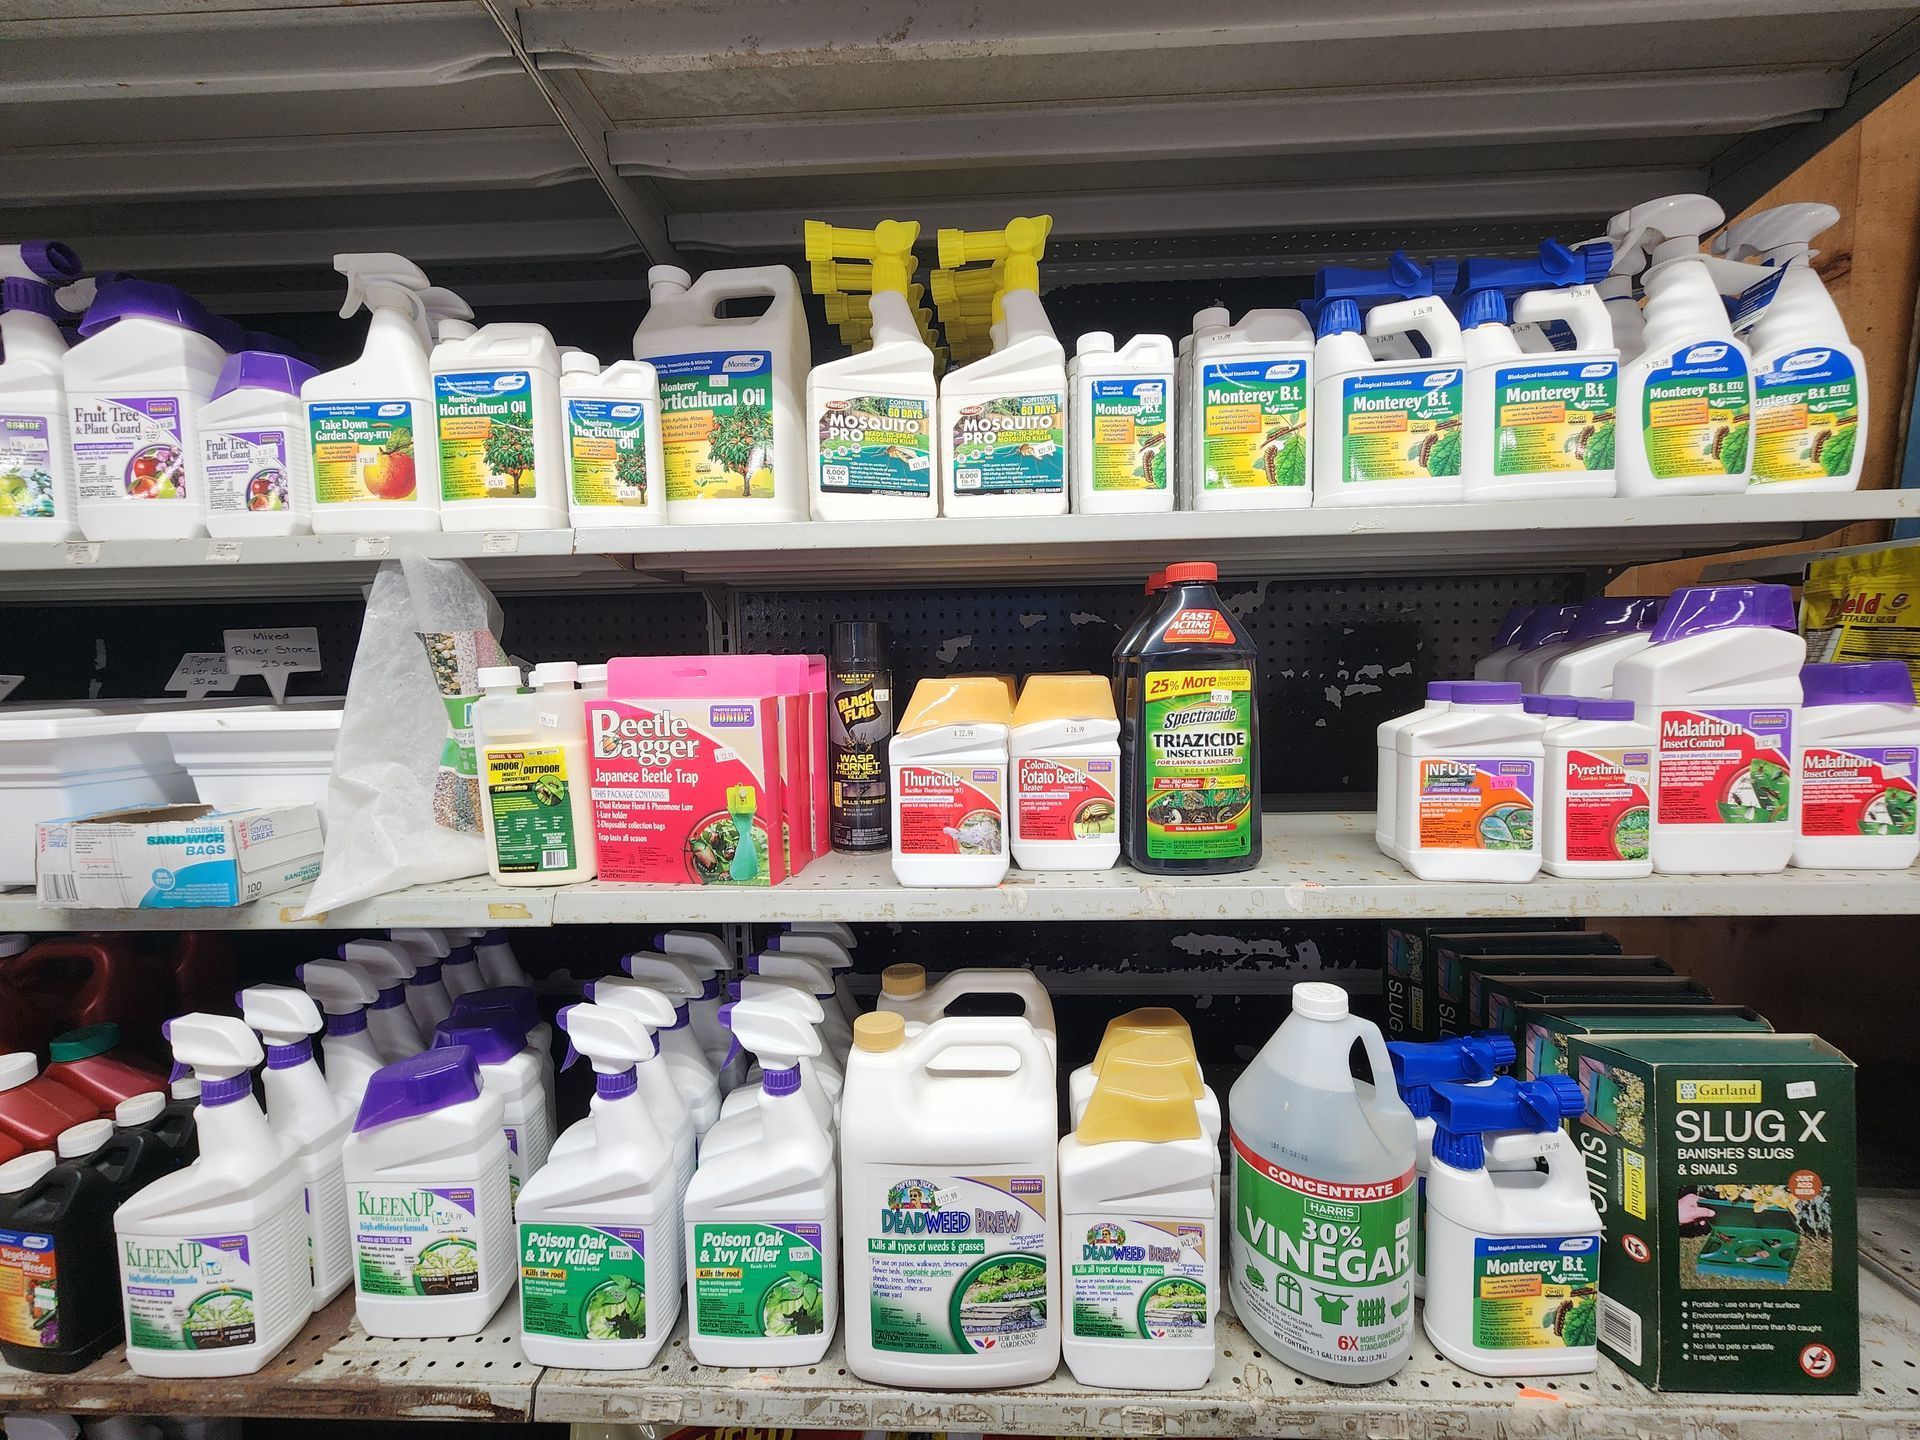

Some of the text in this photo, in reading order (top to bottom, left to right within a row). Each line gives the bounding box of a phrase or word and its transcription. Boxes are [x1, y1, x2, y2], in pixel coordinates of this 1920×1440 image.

[1537, 370, 1568, 378] Insecticide
[661, 382, 695, 392] Monterey
[1506, 383, 1607, 403] Monterey B.t.
[1650, 382, 1743, 399] Monterey B.t. RTU
[660, 388, 765, 410] orticultural Oil
[1208, 386, 1302, 404] Monterey B.t.
[440, 401, 526, 416] Horticultural Oil
[889, 400, 922, 408] CONTROLS
[1354, 392, 1451, 412] Monterey B.t.
[75, 408, 139, 422] Fruit Tree
[888, 409, 923, 419] 60 DAYS
[84, 424, 108, 434] Plant
[112, 422, 141, 434] Guard
[320, 420, 368, 430] Take Down
[583, 420, 612, 428] Monterey
[829, 414, 919, 432] MOSQUITO
[963, 416, 1052, 432] MOSQUITO
[315, 430, 392, 442] Garden Spray-RTU
[574, 425, 639, 439] Horticultural
[829, 428, 863, 442] PRO
[964, 432, 996, 444] PRO
[619, 439, 633, 449] Oil
[1181, 612, 1213, 620] FAST-
[1170, 620, 1210, 629] ACTING
[1177, 628, 1210, 636] FORMULA
[233, 646, 316, 655] River Stone
[191, 656, 213, 665] Tiger
[257, 660, 279, 668] .25
[1151, 675, 1216, 694] 25% More
[838, 688, 874, 712] BLACK
[844, 704, 876, 724] FLAG
[1164, 710, 1236, 728] Spectracide
[591, 710, 689, 737] Beetle
[1663, 720, 1742, 737] Malathion
[1154, 732, 1244, 748] TRIAZICIDE
[1662, 738, 1724, 749] Insect Control
[595, 735, 699, 766] Bagger
[1166, 748, 1234, 758] INSECT KILLER
[840, 754, 876, 763] WASP,
[1025, 760, 1059, 770] Colorado
[1805, 756, 1872, 769] Malathion
[1424, 763, 1476, 776] INFUSE
[1568, 763, 1624, 778] Pyrethrin
[1804, 769, 1858, 778] Insect Control
[595, 768, 698, 787] Japanese Beetle Trap
[903, 770, 960, 787] Thuricide
[1021, 770, 1086, 784] Potato Beetle
[186, 826, 225, 834] RECLOSABLE
[147, 834, 224, 844] SANDWICH
[599, 835, 609, 843] Trap
[185, 845, 225, 855] BAGS
[247, 882, 262, 894] 100
[1699, 1083, 1757, 1099] Garland
[1674, 1110, 1827, 1144] SLUG X
[1677, 1148, 1794, 1160] BANISHES SLUGS
[1678, 1164, 1738, 1175] & SNAILS
[1268, 1166, 1393, 1198] CONCENTRATE
[1310, 1202, 1354, 1217] HARRIS
[882, 1208, 1020, 1234] DEADWEED BREW
[1302, 1218, 1362, 1248] 30%
[528, 1232, 607, 1249] Poison Oak
[1245, 1205, 1409, 1283] VINEGAR
[872, 1242, 886, 1250] Kills
[898, 1243, 916, 1254] types
[918, 1242, 926, 1251] of
[927, 1242, 949, 1251] weeds
[951, 1243, 956, 1251] &
[958, 1243, 984, 1254] grasses
[525, 1248, 603, 1267] & Ivy Killer
[1486, 1256, 1586, 1275] Monterey B.t.
[525, 1269, 538, 1277] Kills
[550, 1271, 564, 1279] root
[1692, 1313, 1770, 1321] Environmentally friendly
[1692, 1323, 1712, 1332] Highly
[1715, 1323, 1750, 1331] successful
[1787, 1324, 1796, 1332] 50
[1798, 1324, 1822, 1333] caught
[1337, 1335, 1359, 1351] 6X
[1726, 1344, 1740, 1352] pets
[1751, 1343, 1774, 1351] wildlife
[1700, 1354, 1716, 1363] really
